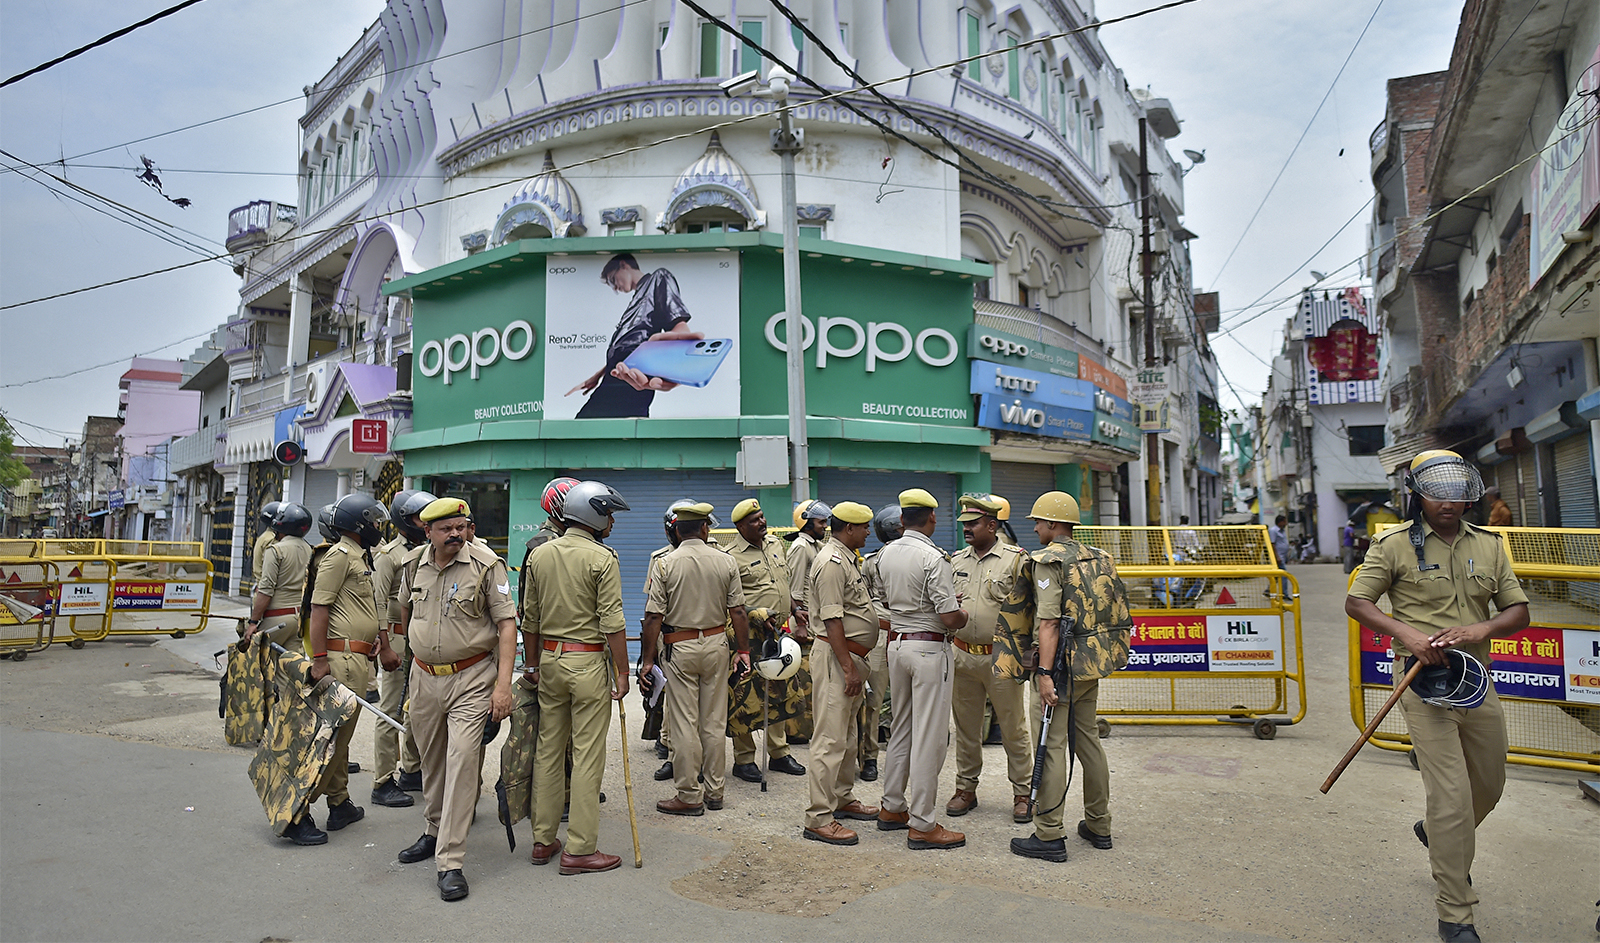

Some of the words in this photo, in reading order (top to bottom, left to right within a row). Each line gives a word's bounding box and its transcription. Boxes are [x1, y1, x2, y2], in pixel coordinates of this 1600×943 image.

[549, 267, 576, 275] oppo
[549, 334, 577, 344] Reno7
[580, 334, 606, 343] Series
[764, 311, 959, 373] oppo
[419, 320, 536, 386] oppo
[980, 335, 1029, 356] oppo
[1030, 349, 1053, 363] Camera
[1056, 355, 1075, 369] Phone
[474, 406, 500, 420] BEAUTY
[501, 400, 544, 416] COLLECTION
[862, 403, 903, 416] BEAUTY
[905, 405, 967, 419] COLLECTION
[1000, 400, 1045, 428] vivo
[1048, 415, 1065, 426] Smart
[1067, 418, 1084, 430] Phone
[1177, 623, 1186, 639] से
[1521, 637, 1532, 656] से
[1152, 652, 1206, 666] प्रयागराज
